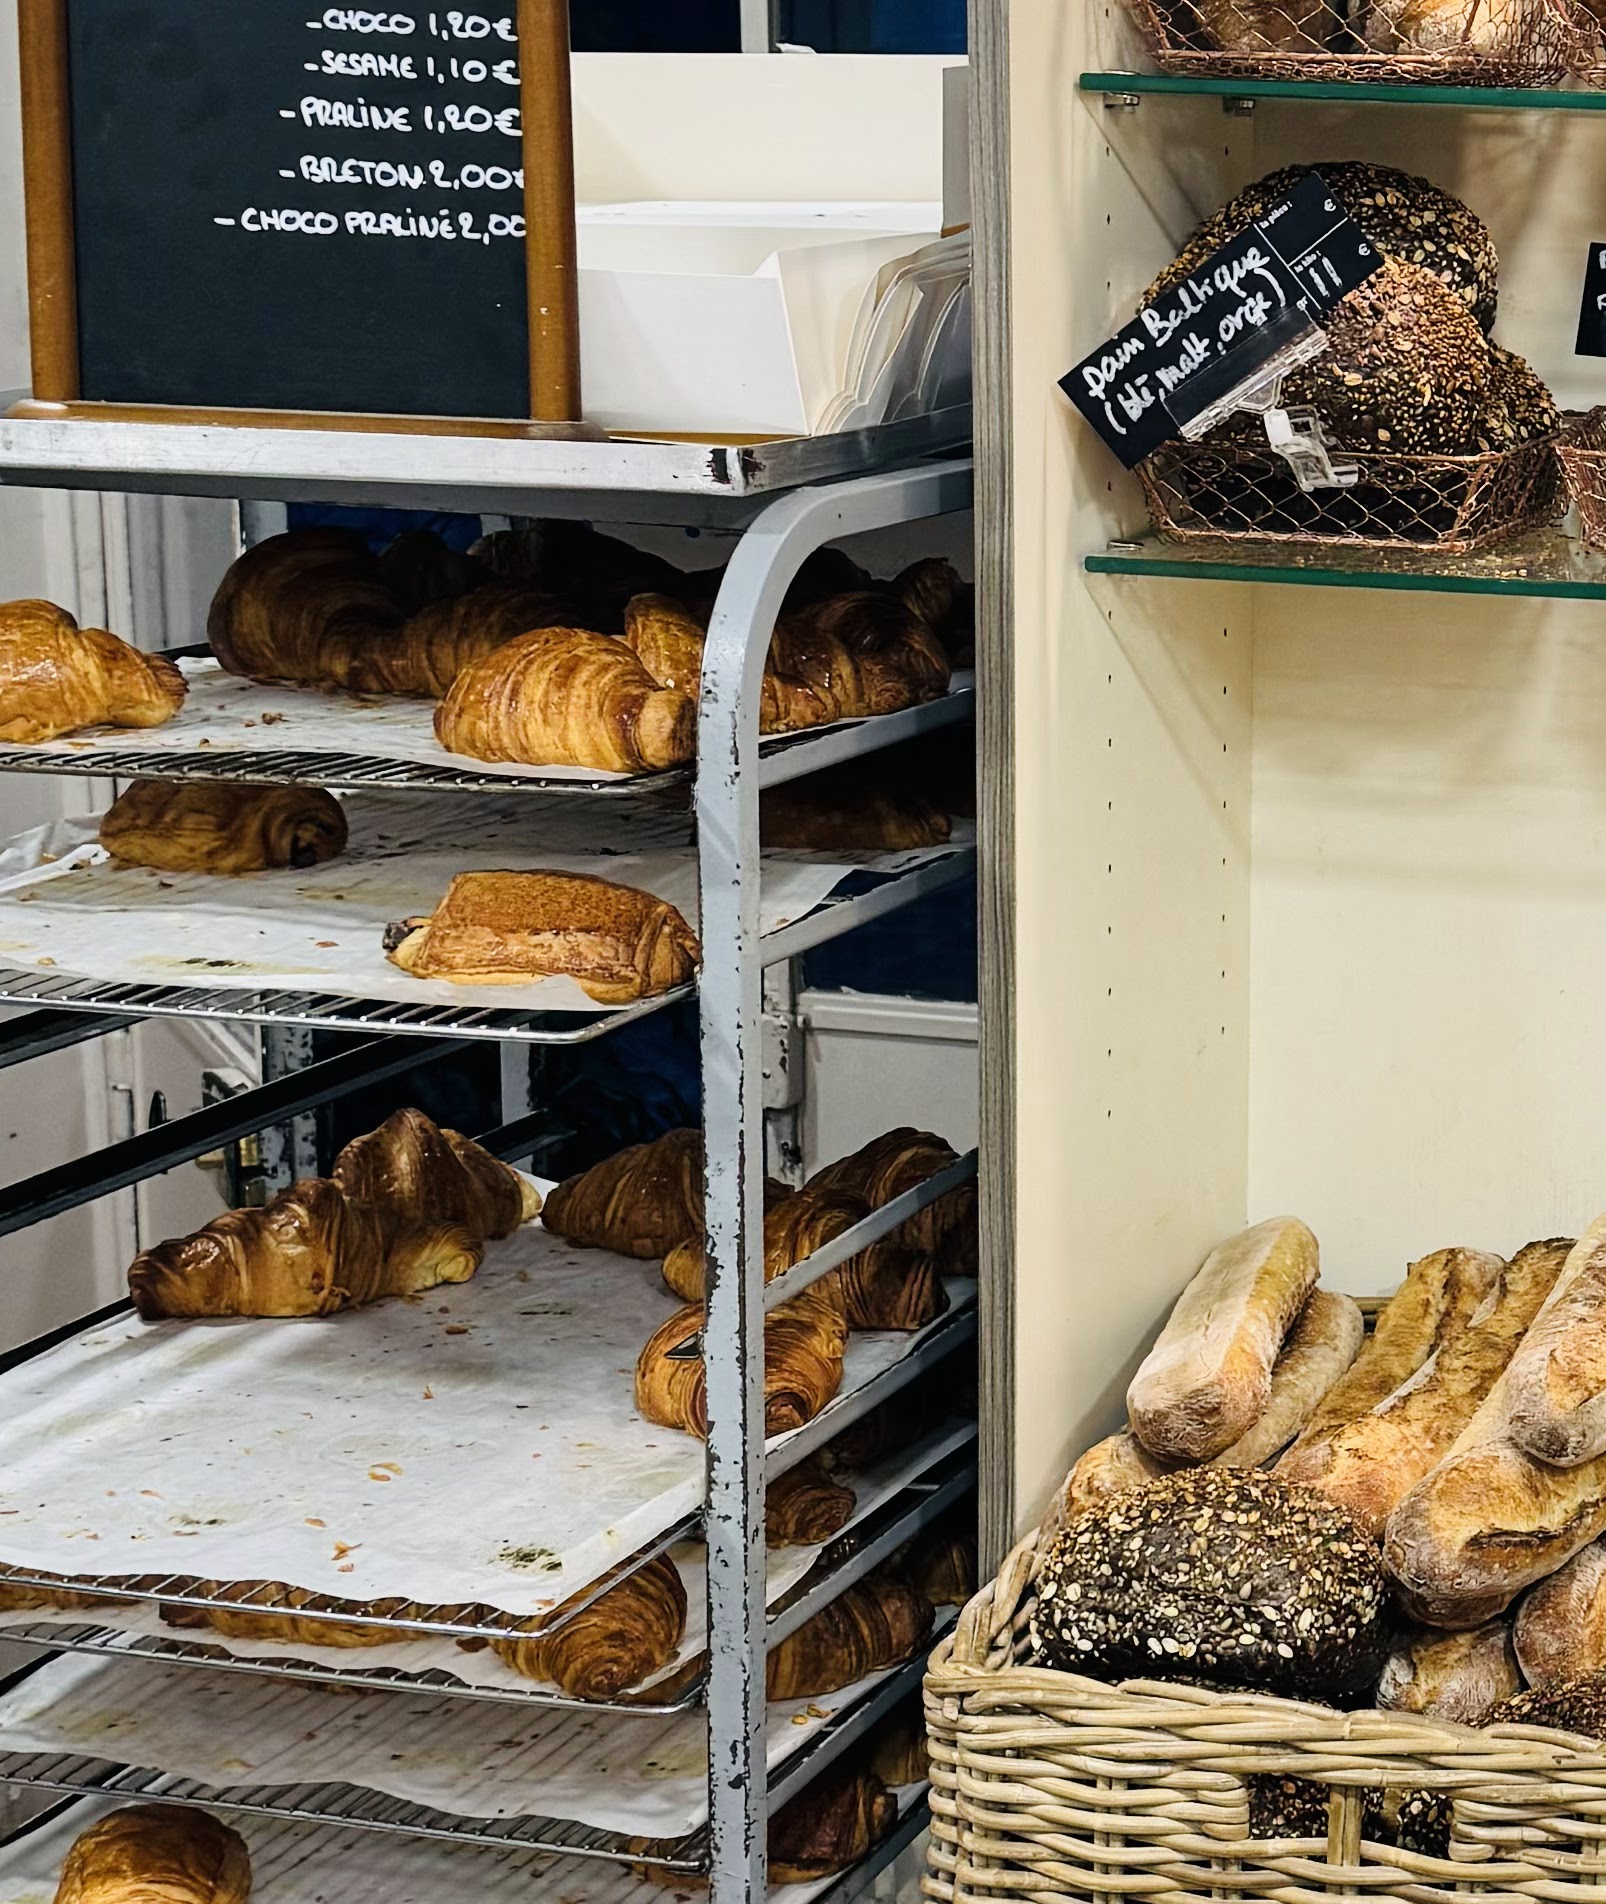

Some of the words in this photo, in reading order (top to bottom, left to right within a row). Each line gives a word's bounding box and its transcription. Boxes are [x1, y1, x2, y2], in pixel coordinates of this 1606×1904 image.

[429, 10, 519, 42] 1,20€
[427, 56, 522, 86] 1,10€
[424, 104, 524, 137] 1,20€
[345, 207, 457, 240] PRALINÉ
[1082, 337, 1145, 401] Pain
